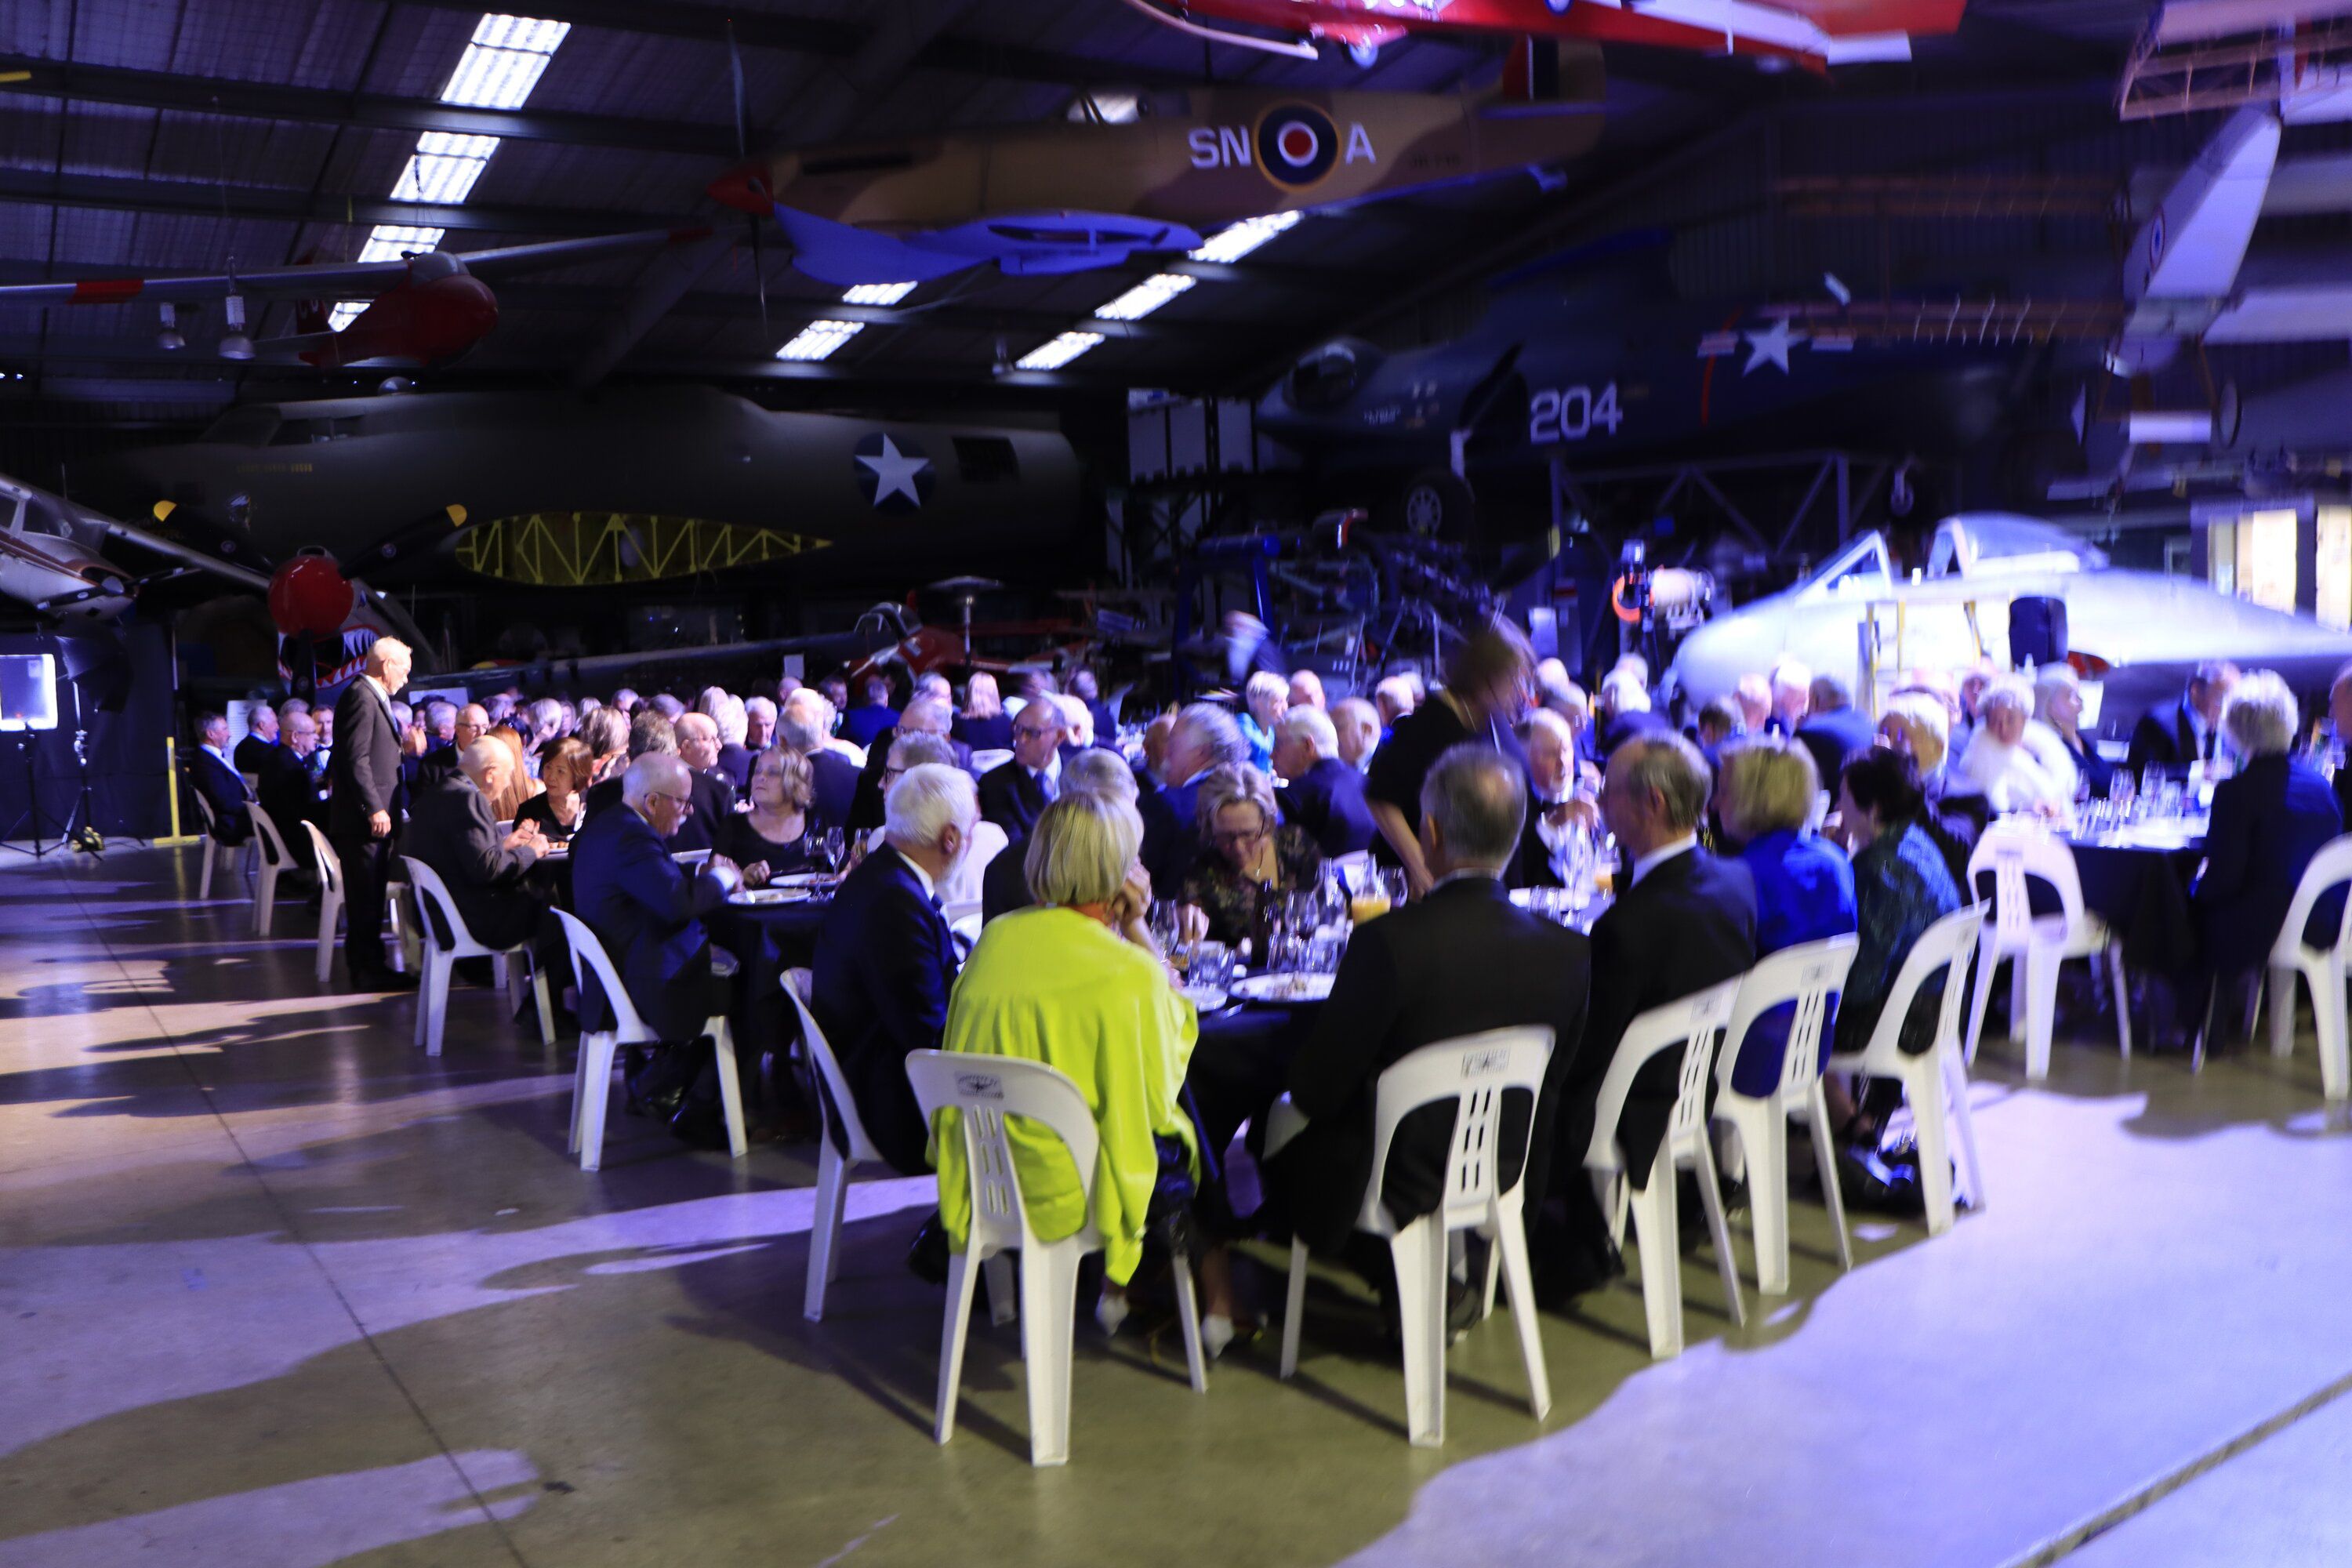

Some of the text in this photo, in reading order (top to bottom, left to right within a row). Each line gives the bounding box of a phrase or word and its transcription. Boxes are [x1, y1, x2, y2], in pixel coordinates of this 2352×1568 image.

[1188, 122, 1377, 169] SN A
[1530, 379, 1623, 444] 204
